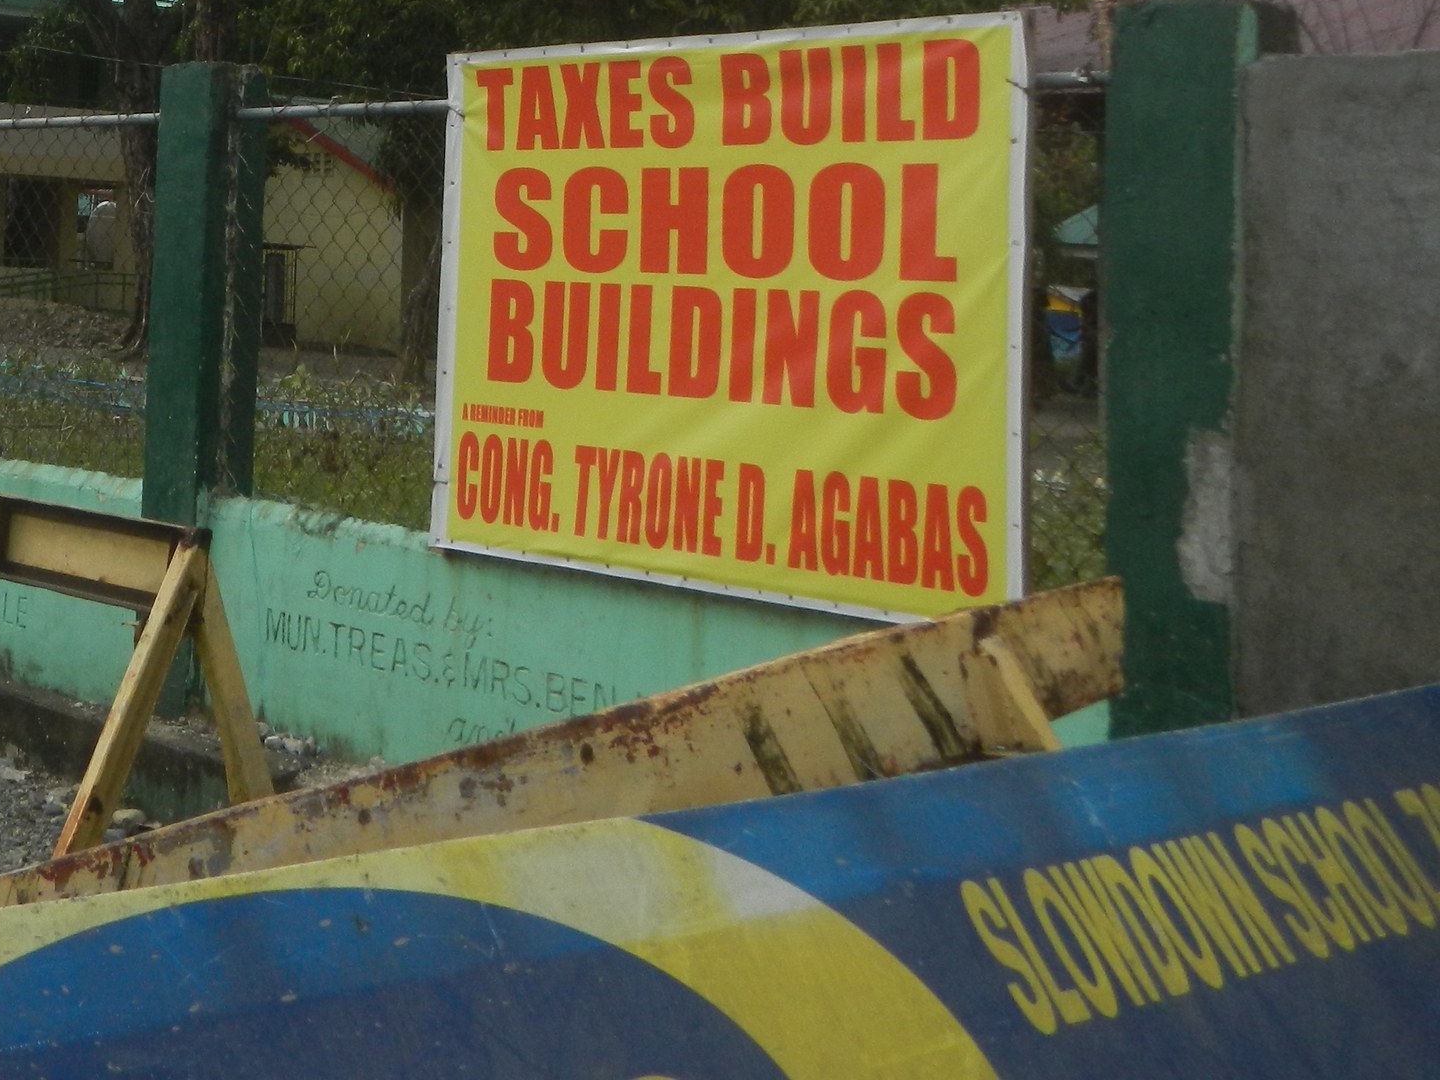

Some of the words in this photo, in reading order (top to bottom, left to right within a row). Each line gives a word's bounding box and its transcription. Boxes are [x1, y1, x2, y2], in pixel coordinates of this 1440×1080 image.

[477, 56, 695, 151] TAXES
[720, 38, 981, 146] BUILD
[493, 162, 958, 282] SCHOOL
[487, 278, 958, 420] BUILDINGS
[462, 403, 469, 421] A
[470, 404, 516, 426] REMINDER
[518, 409, 544, 429] FROM
[456, 431, 559, 533] CONG.
[573, 445, 725, 557] TYRONE
[735, 463, 776, 565] D.
[787, 469, 989, 597] AGABAS
[307, 570, 435, 626] Donated
[960, 831, 1297, 1036] SLOWDOWN
[1234, 797, 1440, 959] SCHOOL
